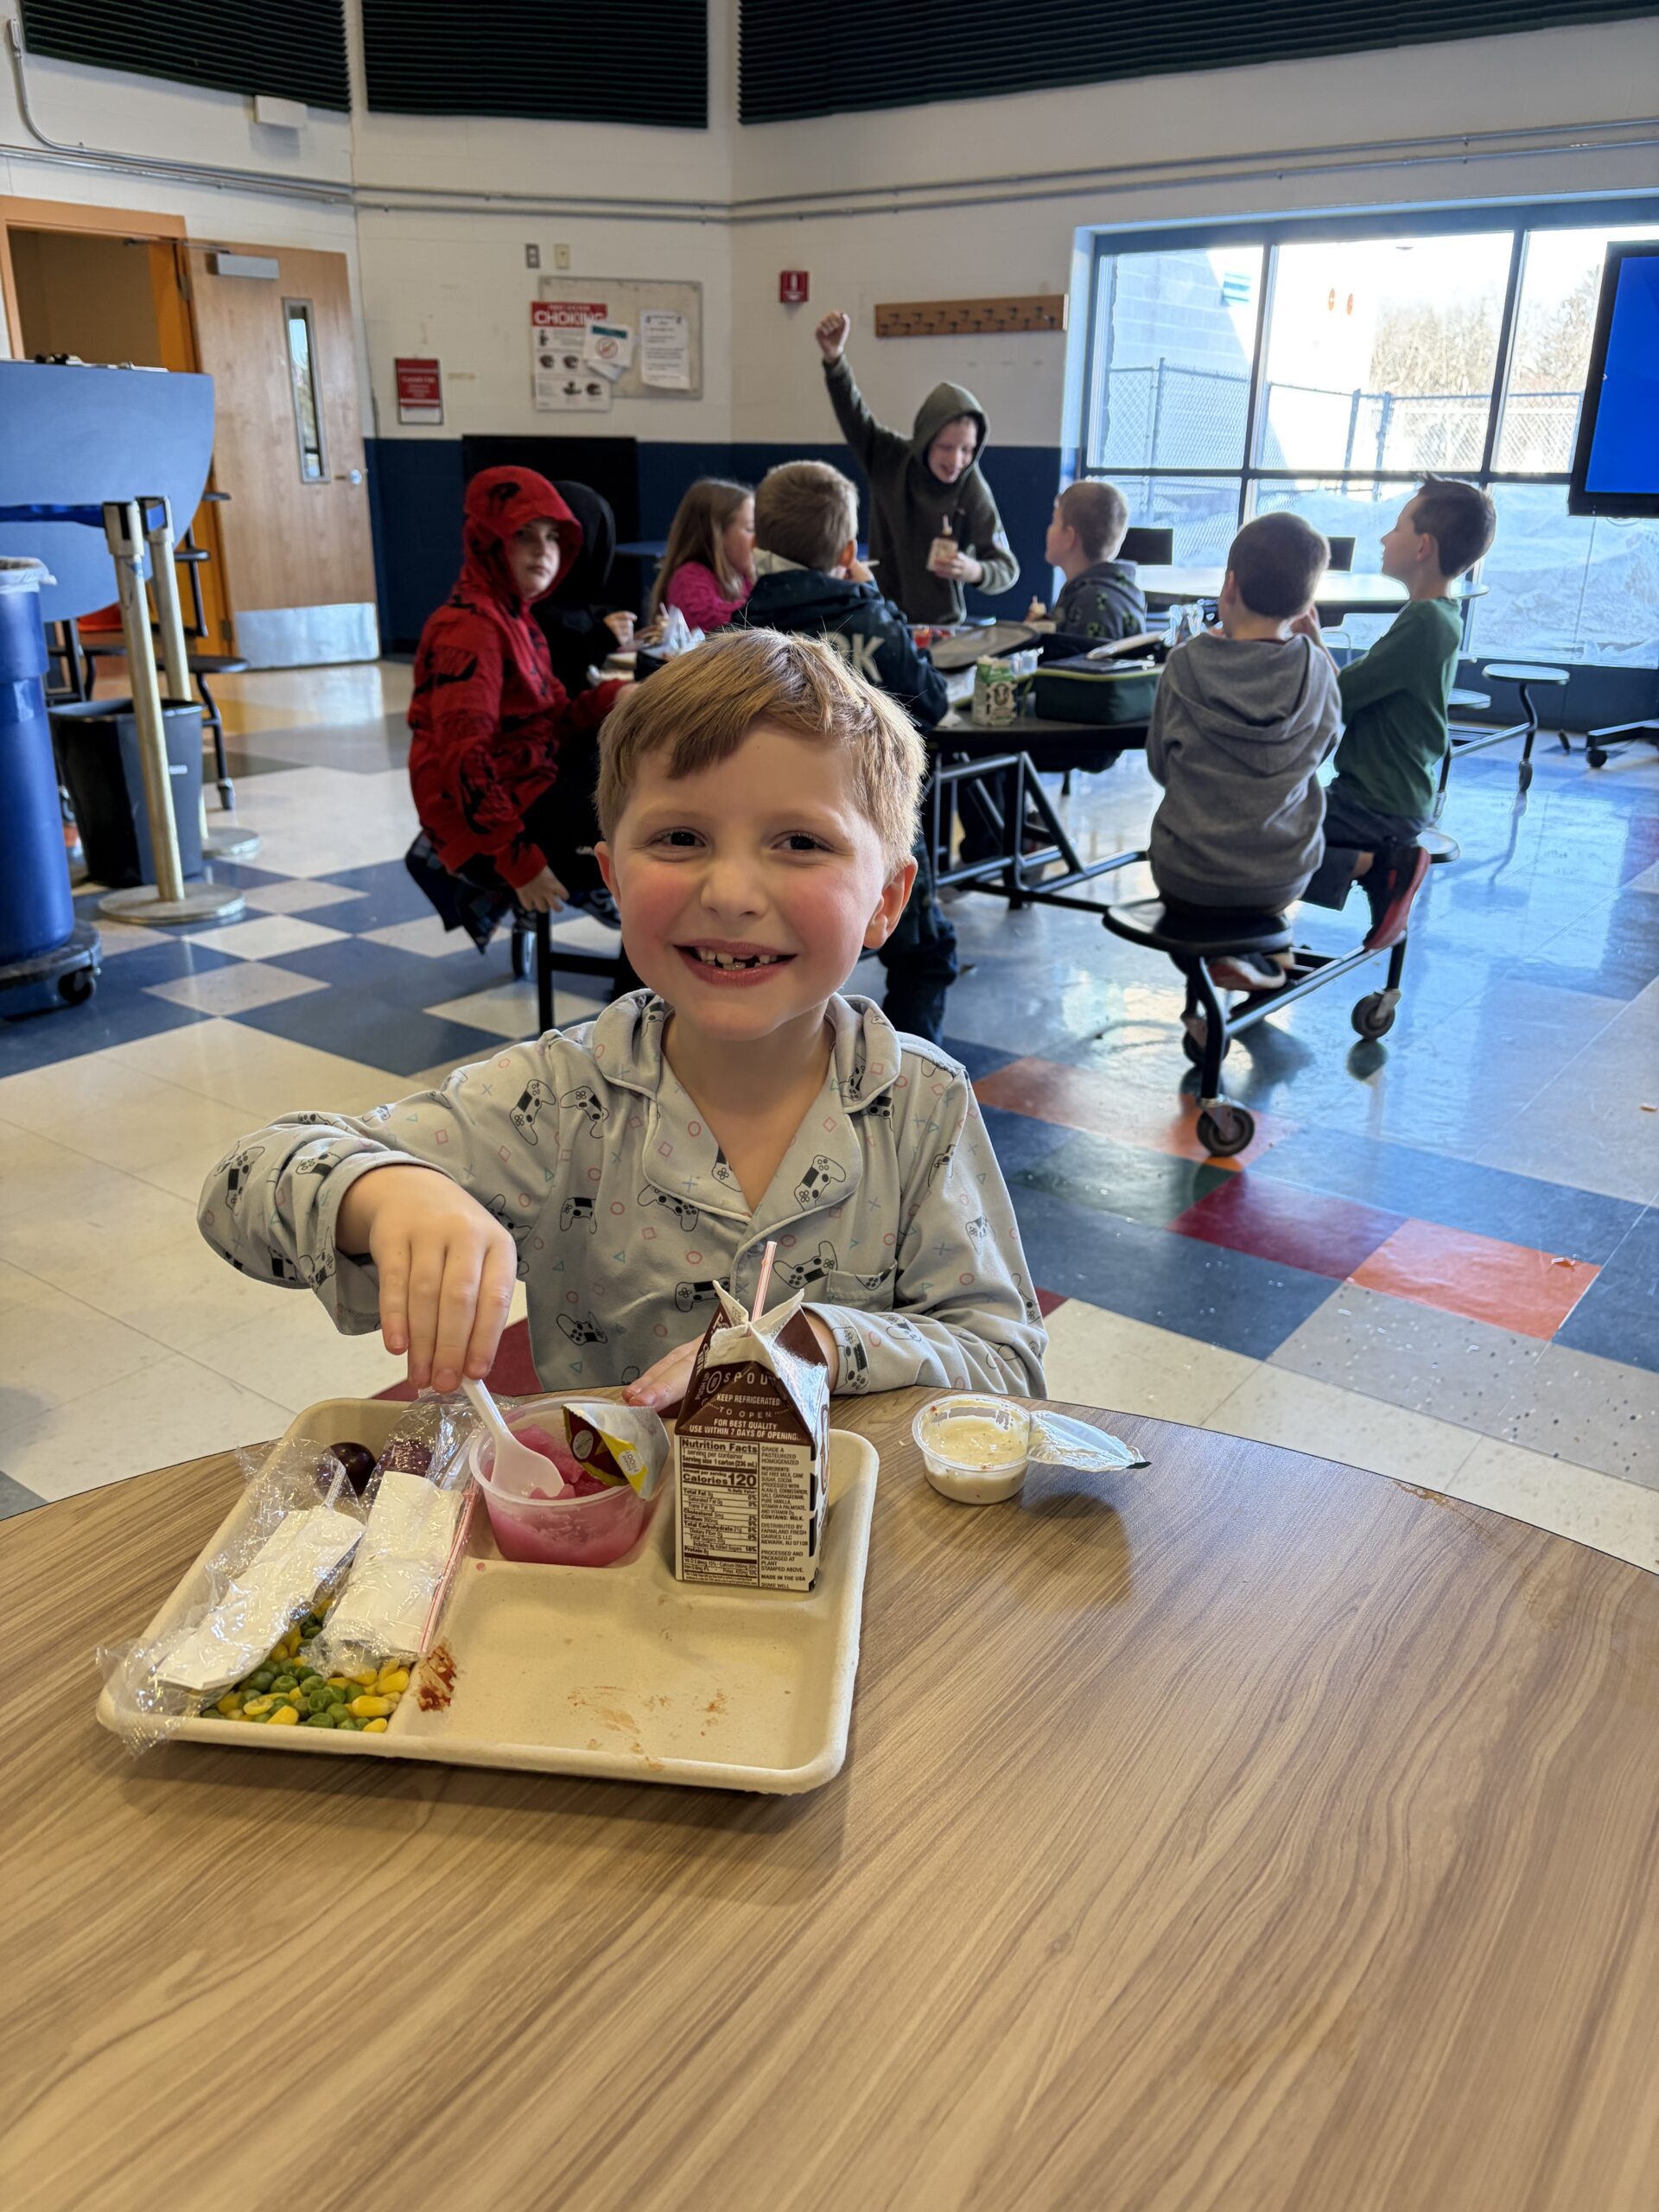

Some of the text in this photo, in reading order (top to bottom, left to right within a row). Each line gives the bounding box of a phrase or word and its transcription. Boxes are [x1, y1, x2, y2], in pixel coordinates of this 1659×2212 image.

[716, 1393, 780, 1406] KEEP REFRIGERATED
[719, 1406, 733, 1415] TO
[714, 1418, 778, 1430] FOR BEST QUALITY
[704, 1426, 729, 1434] WITHIN
[736, 1428, 755, 1437] DAYS
[682, 1439, 758, 1452] Nutrition Facts
[683, 1455, 701, 1464] Serving
[687, 1450, 706, 1459] serving
[683, 1473, 757, 1486] Calories 120
[698, 1522, 733, 1531] Carbohydrate
